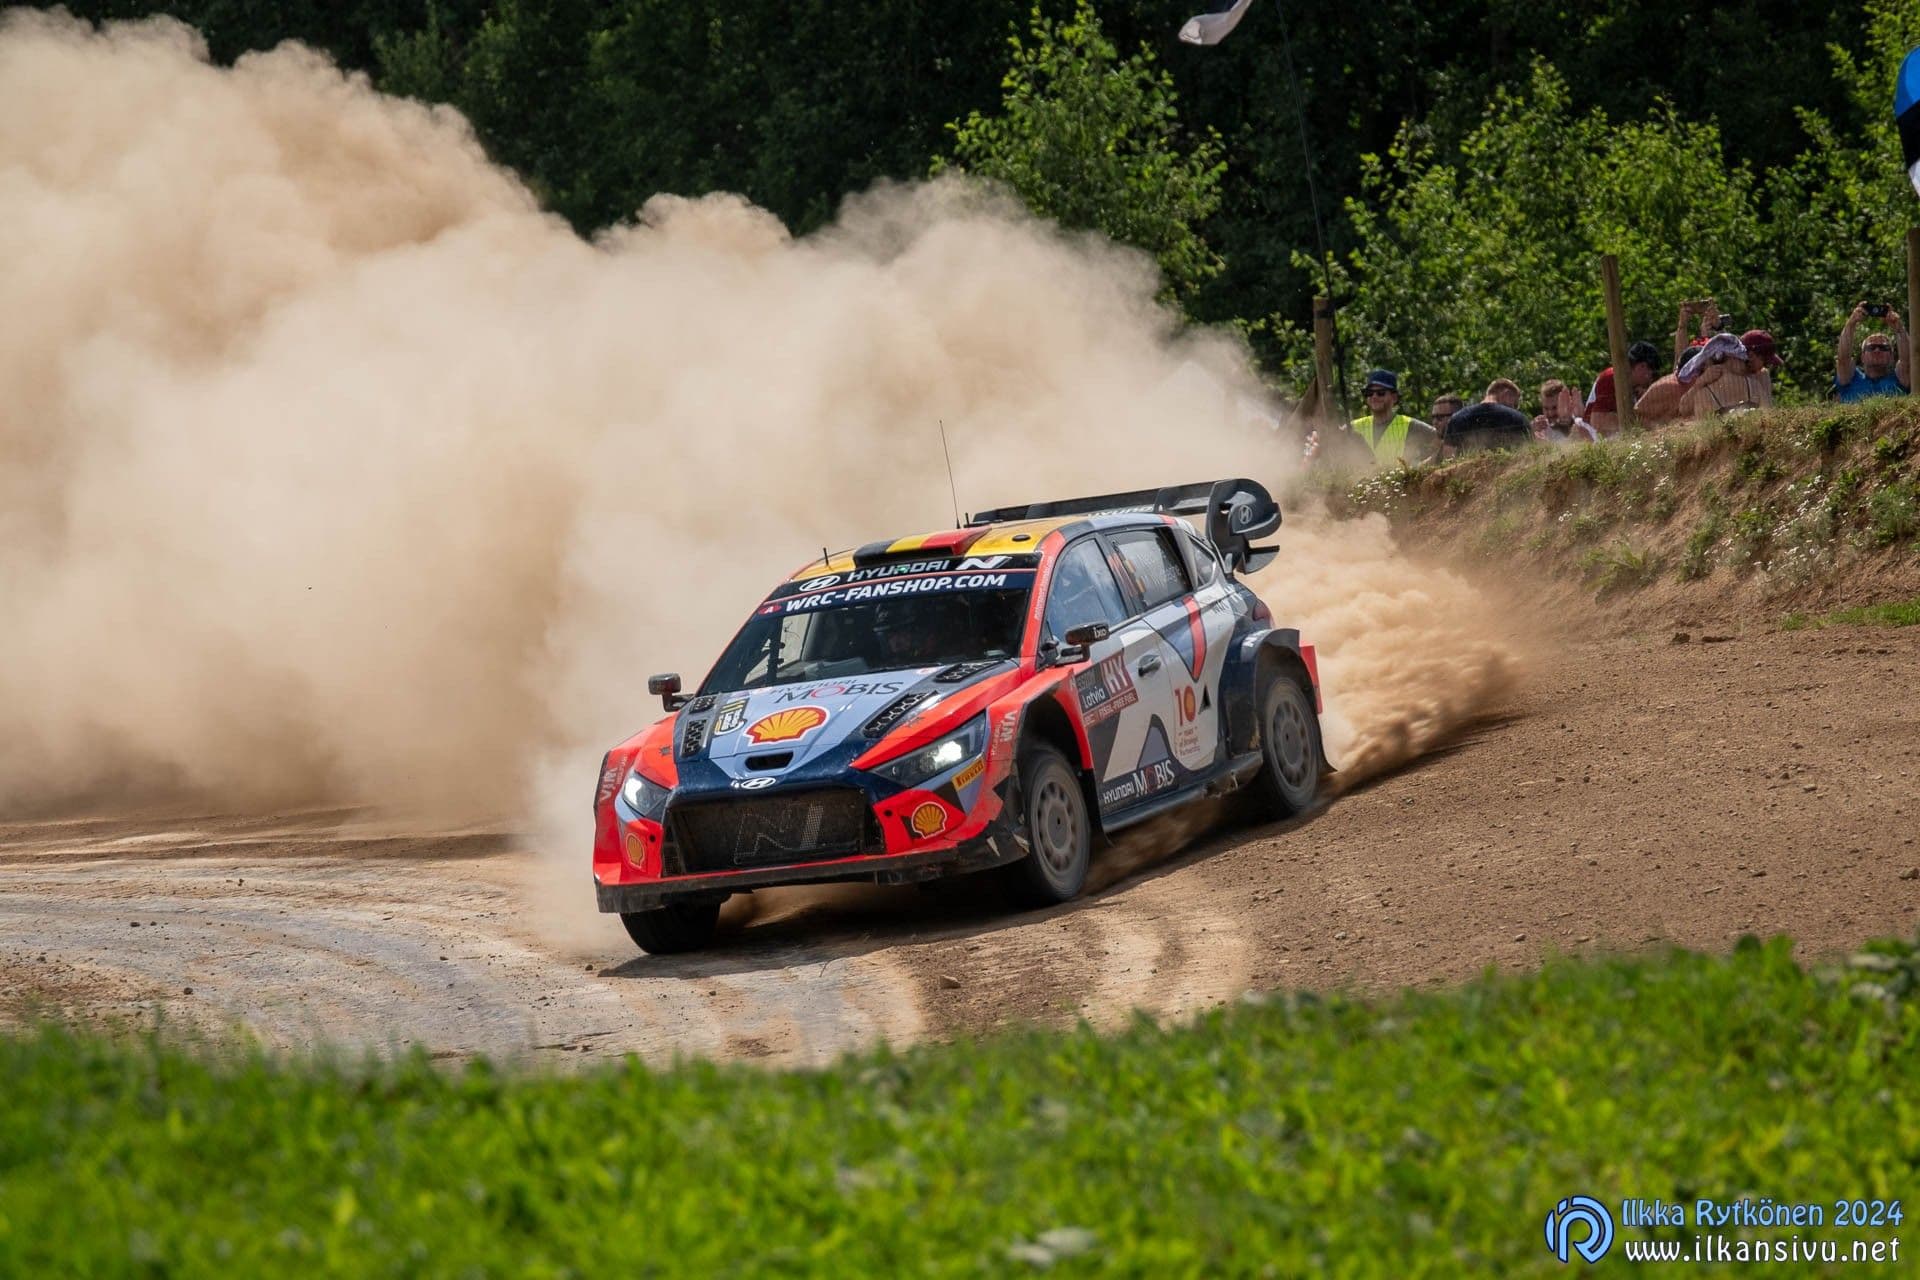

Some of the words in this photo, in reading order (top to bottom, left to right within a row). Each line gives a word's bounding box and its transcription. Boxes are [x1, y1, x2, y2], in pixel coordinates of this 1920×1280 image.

[847, 560, 950, 582] HYUNDAI
[786, 574, 1007, 612] WRC-FANSHOP.COM
[1093, 626, 1107, 639] ixo
[1103, 655, 1128, 694] HY
[774, 681, 904, 704] MOBIS
[1082, 686, 1106, 709] Latvia
[1103, 781, 1135, 804] HYUNDAI
[1133, 760, 1175, 797] MOBIS
